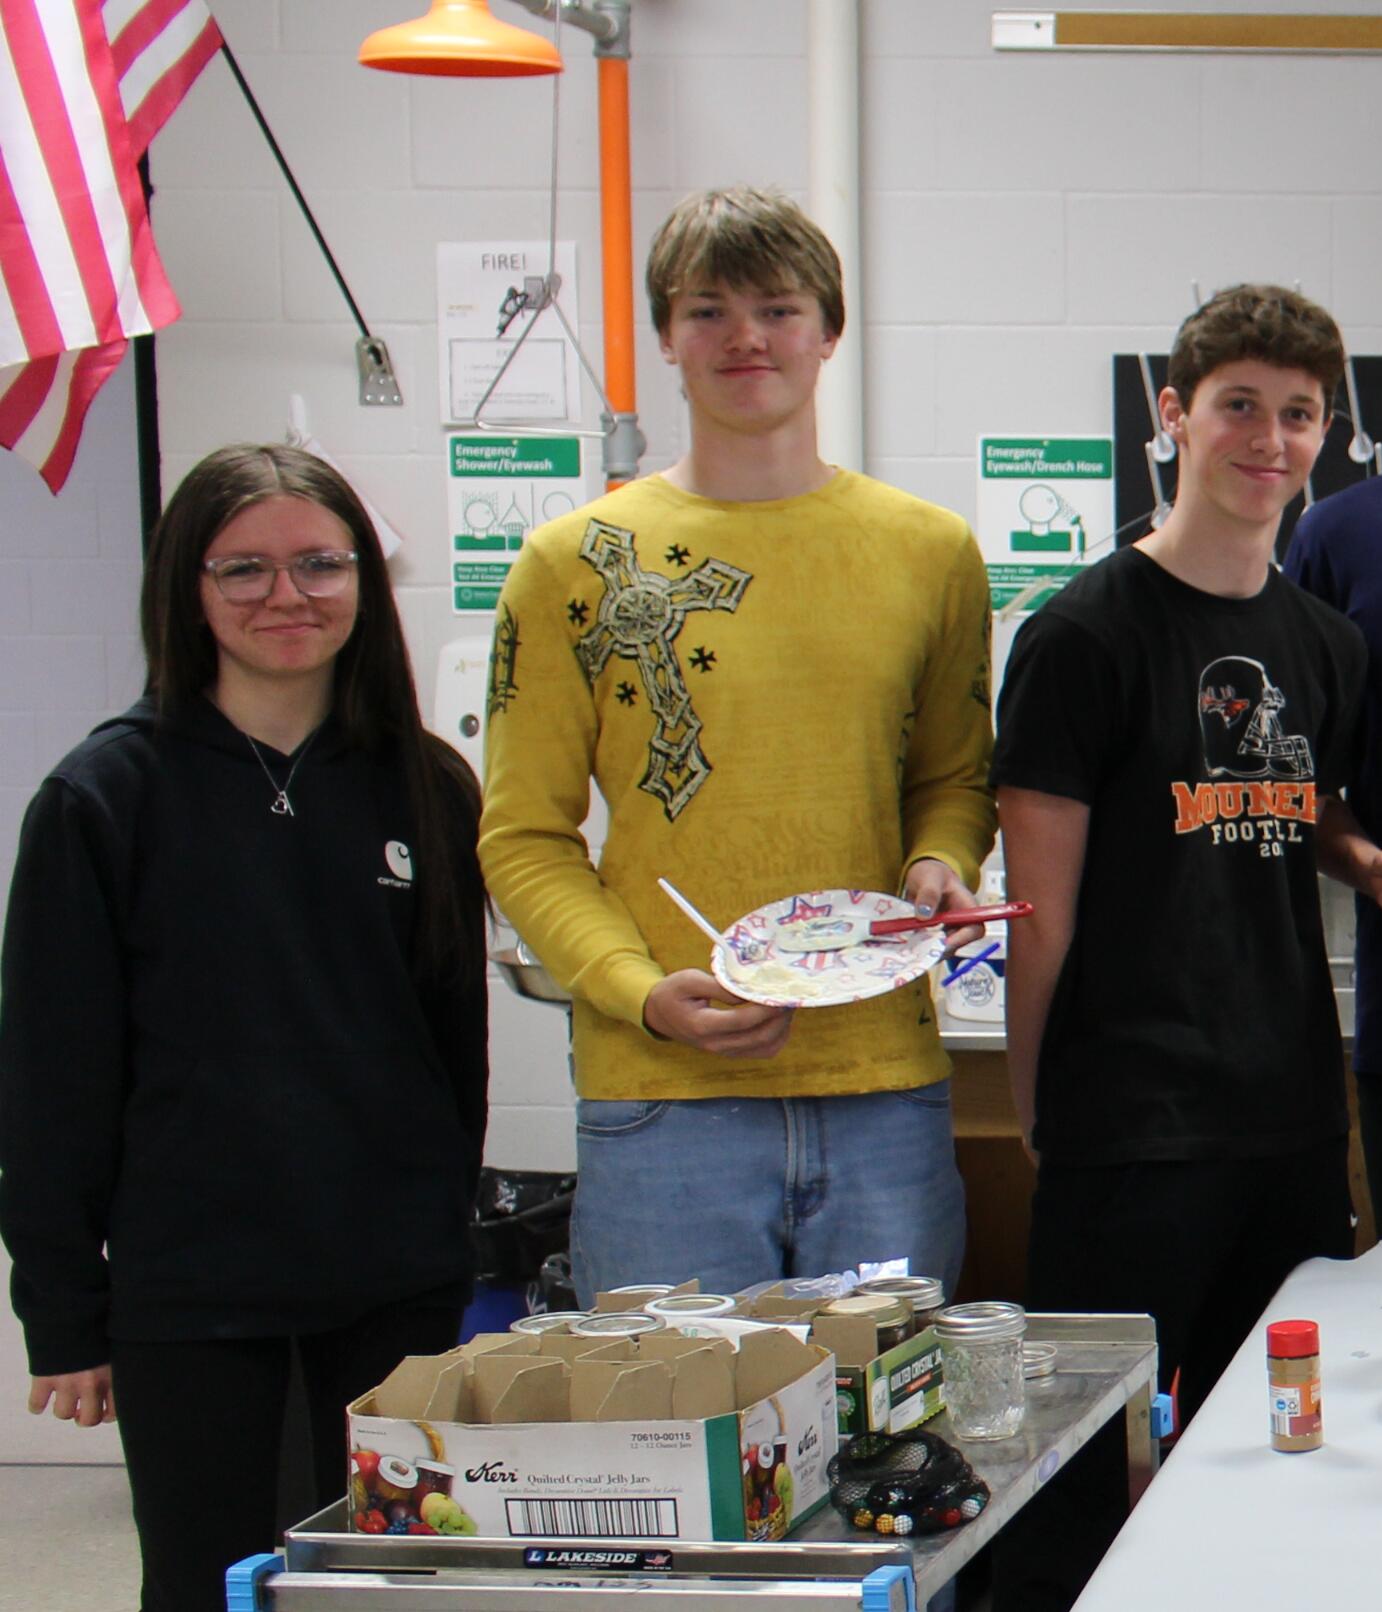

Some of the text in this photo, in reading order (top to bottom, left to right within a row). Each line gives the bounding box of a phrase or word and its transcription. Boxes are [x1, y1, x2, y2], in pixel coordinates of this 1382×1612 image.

[481, 254, 526, 271] FIRE!
[455, 444, 518, 459] Emergency
[986, 446, 1044, 460] Emergency
[455, 459, 553, 474] Shower/Eyewash
[986, 460, 1104, 474] Eyewash/Drench Hose
[631, 1432, 692, 1442] 70610-00115
[465, 1461, 519, 1484] Kerr
[527, 1474, 651, 1486] Quilted Crystal Jelly Jars
[545, 1551, 638, 1563] LAKESIDE
